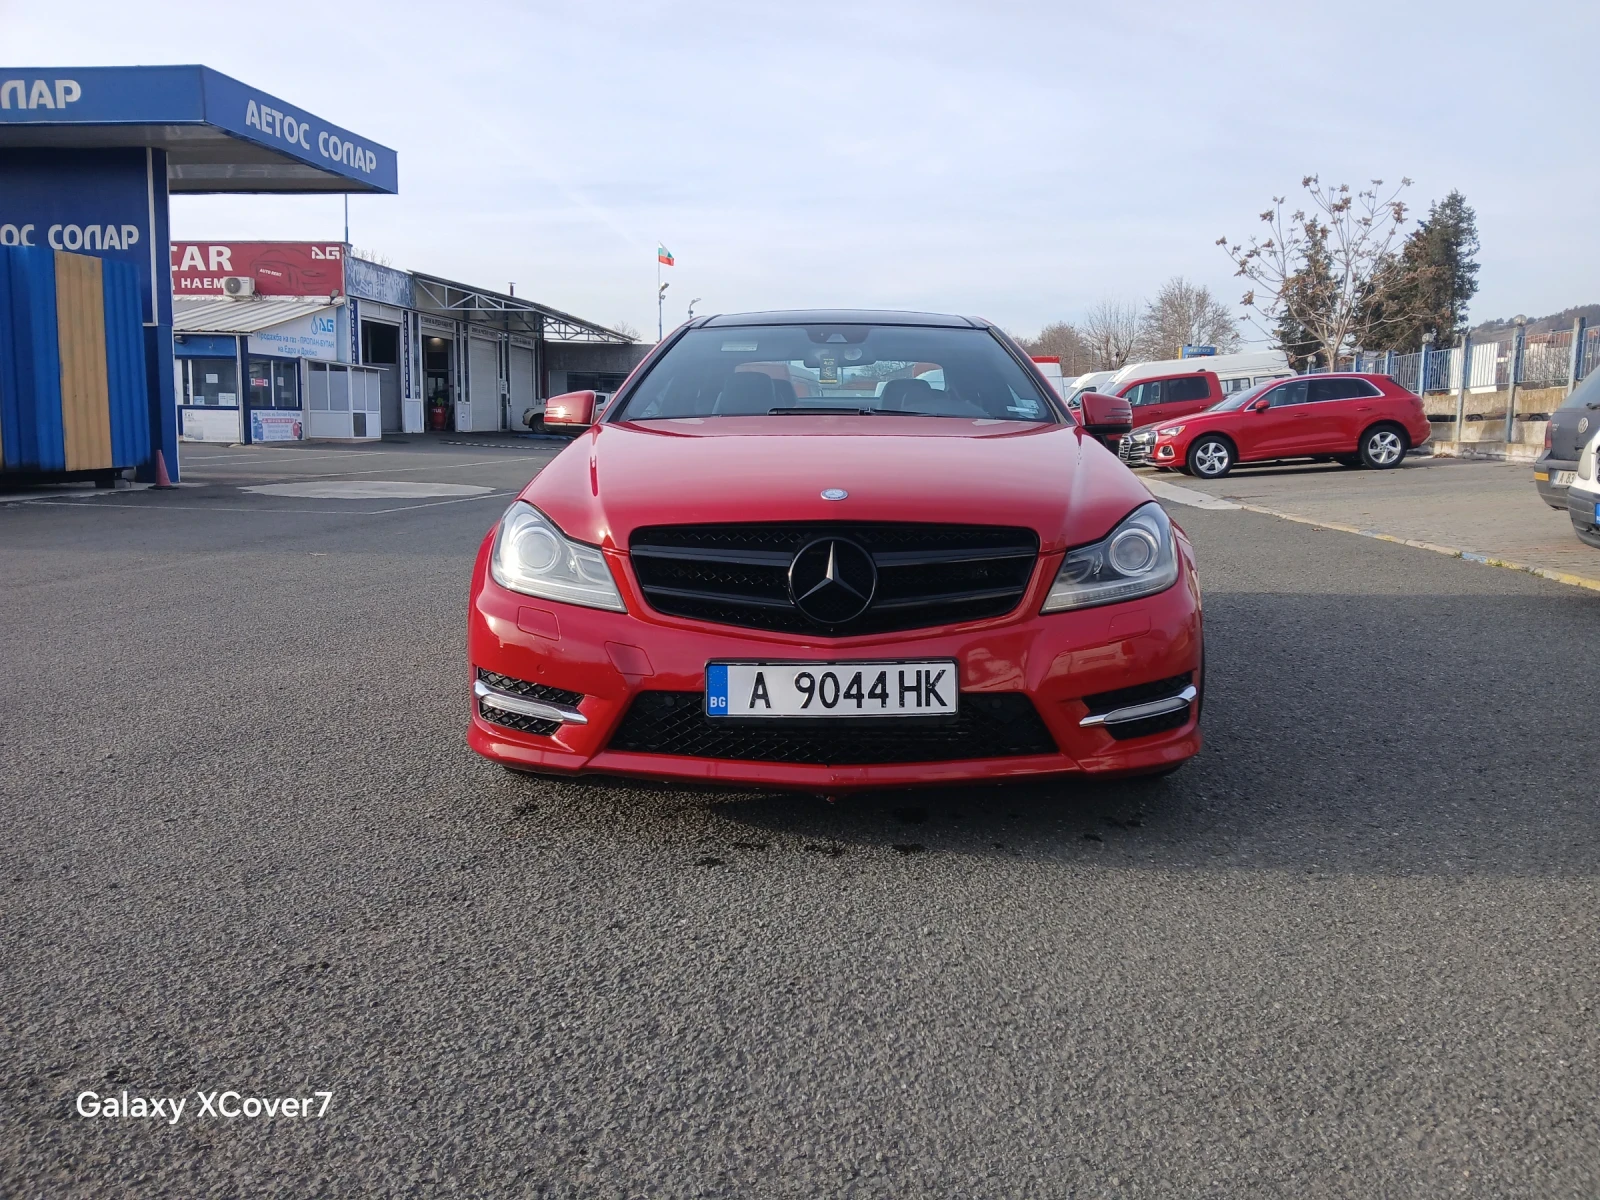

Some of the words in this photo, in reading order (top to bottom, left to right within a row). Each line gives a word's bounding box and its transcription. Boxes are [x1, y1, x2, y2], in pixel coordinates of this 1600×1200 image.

[245, 99, 310, 150] АЕТОС
[318, 131, 377, 174] СОЛАР
[48, 224, 140, 250] СОЛАР
[710, 696, 727, 708] BG
[748, 671, 772, 709] A
